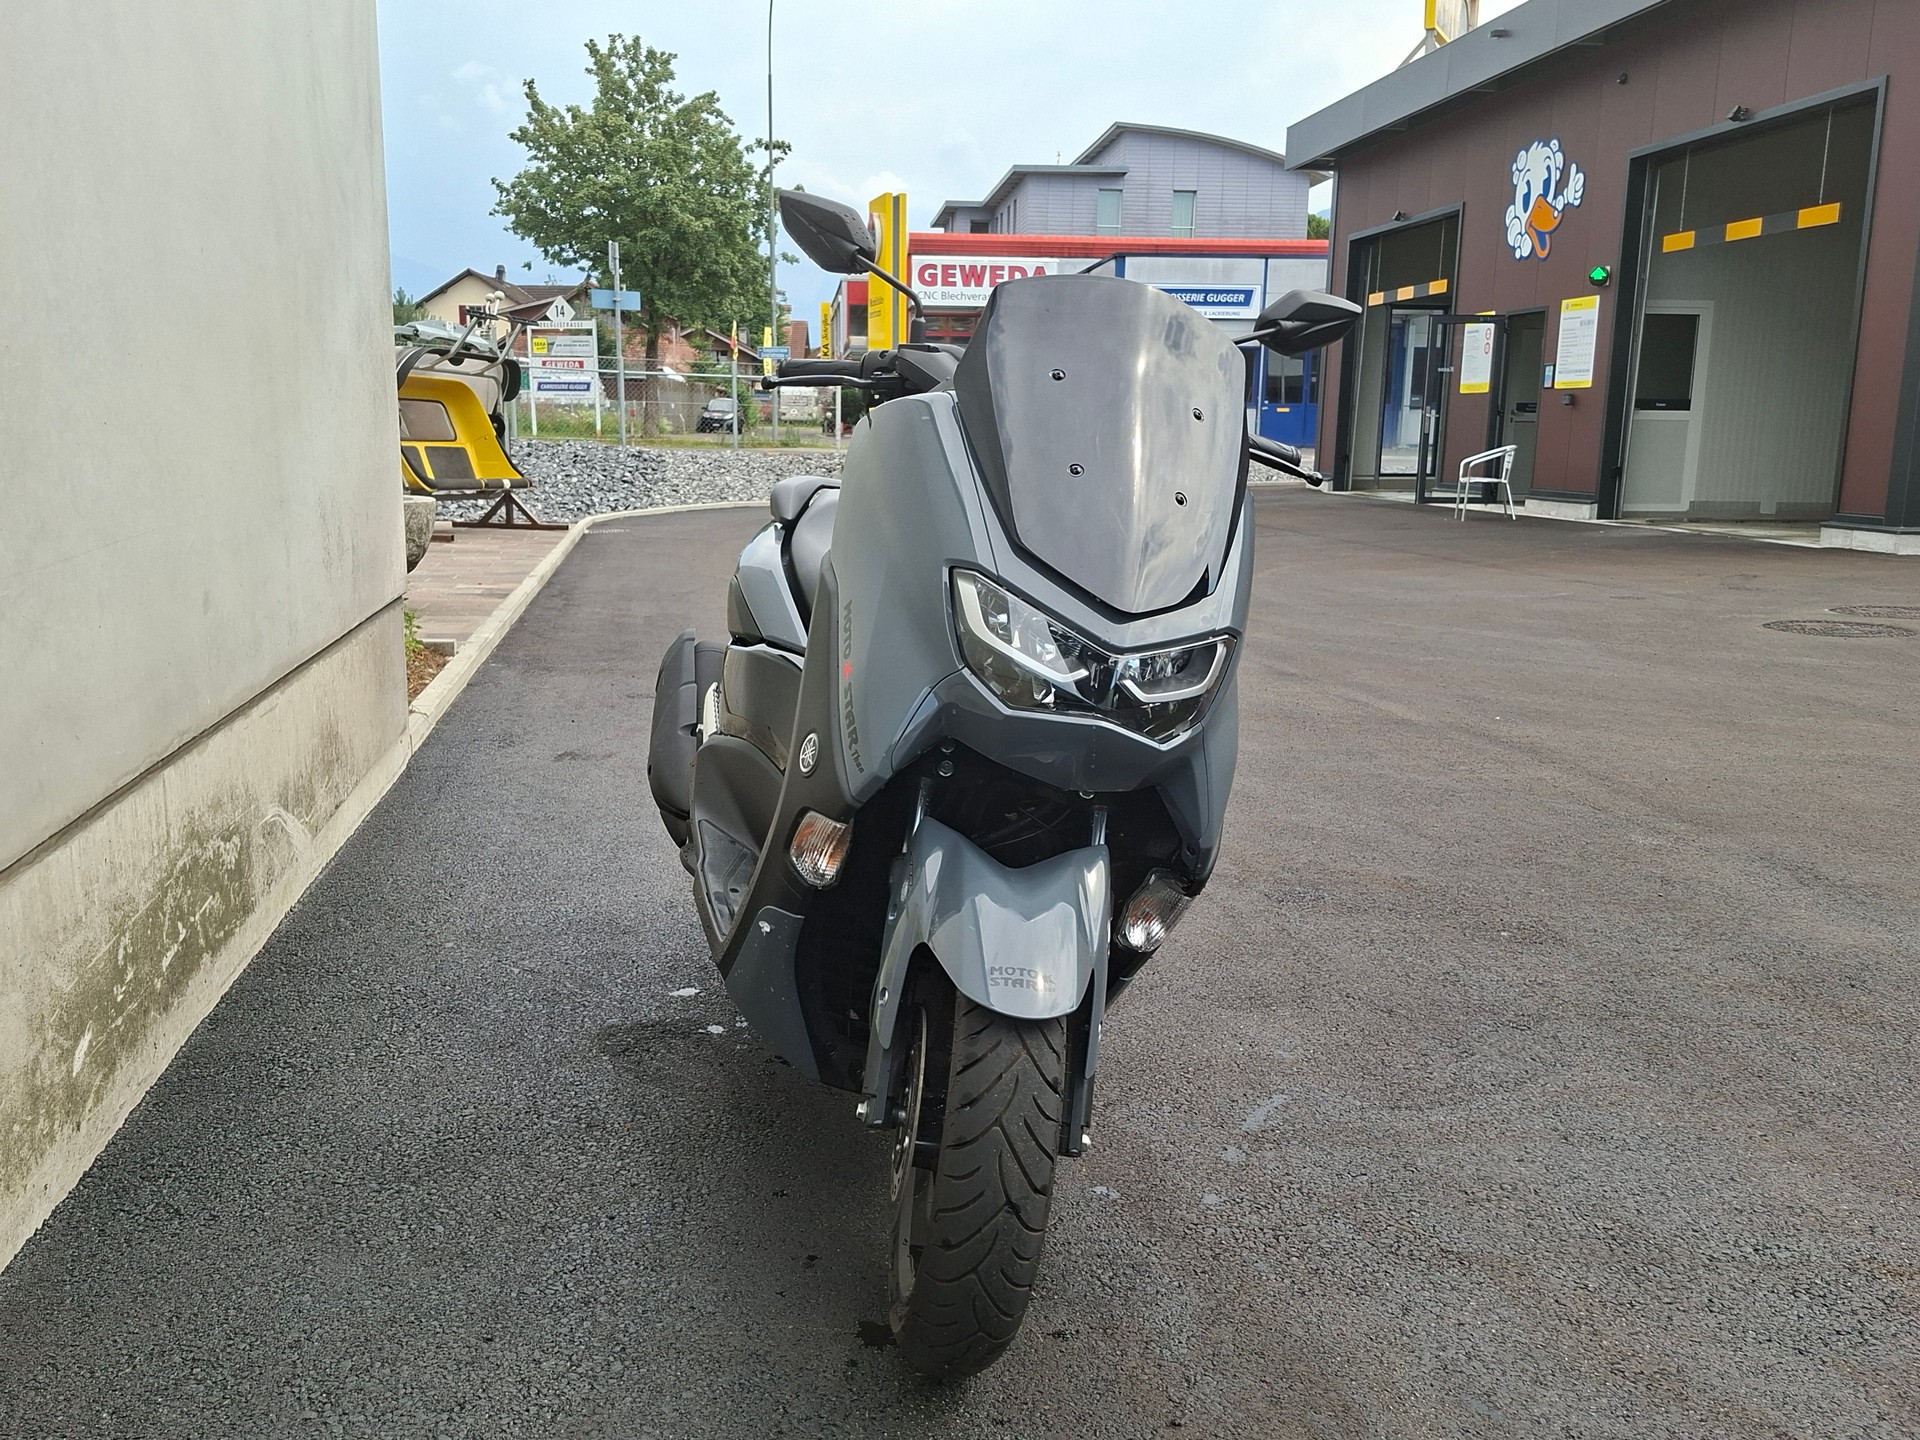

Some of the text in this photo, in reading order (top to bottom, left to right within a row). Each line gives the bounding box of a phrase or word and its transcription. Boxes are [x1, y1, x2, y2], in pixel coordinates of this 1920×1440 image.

[918, 290, 991, 301] CNC Blechvera
[1206, 293, 1245, 303] GUGGER
[555, 305, 565, 317] 14
[822, 343, 830, 357] KA
[545, 360, 580, 369] GEWEDA
[843, 599, 853, 661] MOTO
[990, 966, 1039, 980] MOTO
[990, 976, 1040, 993] STAR
